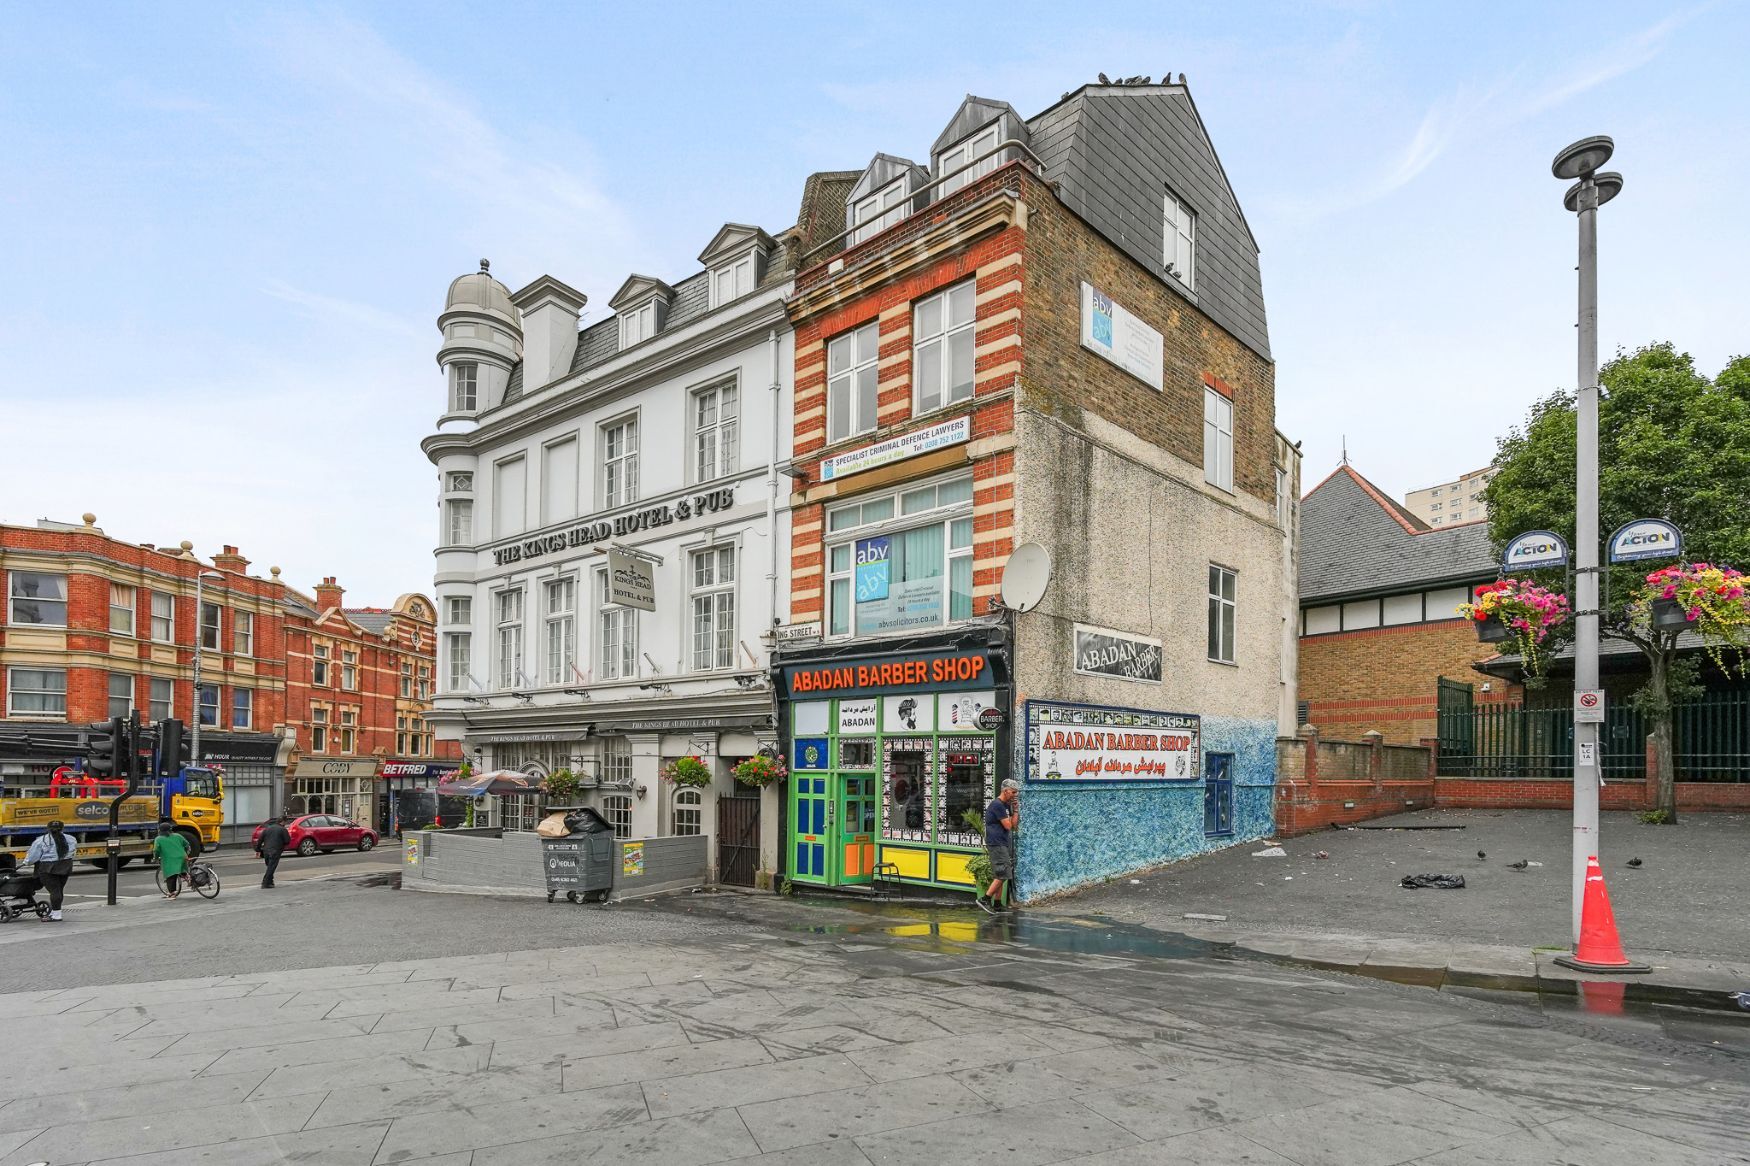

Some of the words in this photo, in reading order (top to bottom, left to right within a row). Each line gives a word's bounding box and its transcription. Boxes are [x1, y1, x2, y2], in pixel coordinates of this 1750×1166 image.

[1093, 294, 1112, 318] abv
[836, 450, 868, 466] SPECIALIST
[870, 442, 900, 456] CRIMINAL
[901, 431, 930, 446] DEFENCE
[931, 420, 964, 437] LAWYERS
[494, 547, 521, 566] THE
[522, 532, 566, 558] KINGS
[567, 522, 612, 547] HEAD
[613, 506, 673, 535] HOTEL
[674, 500, 691, 521] &
[693, 488, 734, 516] PUB
[1621, 532, 1670, 546] ACTON
[857, 542, 888, 565] abv
[1514, 542, 1557, 556] ACTON
[614, 576, 634, 586] KINGS
[614, 588, 634, 599] HOTEL
[878, 613, 938, 628] abvsolicitors.co.uk
[790, 627, 812, 638] STREET
[1081, 642, 1137, 670] ABADAN
[1124, 645, 1159, 678] BARBER
[793, 666, 854, 692] ABADAN
[858, 661, 928, 686] BARBER
[932, 656, 985, 682] SHOP
[842, 718, 875, 727] ABADAN
[1043, 731, 1105, 750] ABADAN
[1107, 733, 1160, 751] BARBER
[1160, 736, 1190, 751] SHOP
[948, 753, 978, 763] OPEN
[383, 764, 427, 775] BETFRED
[78, 805, 109, 815] selco
